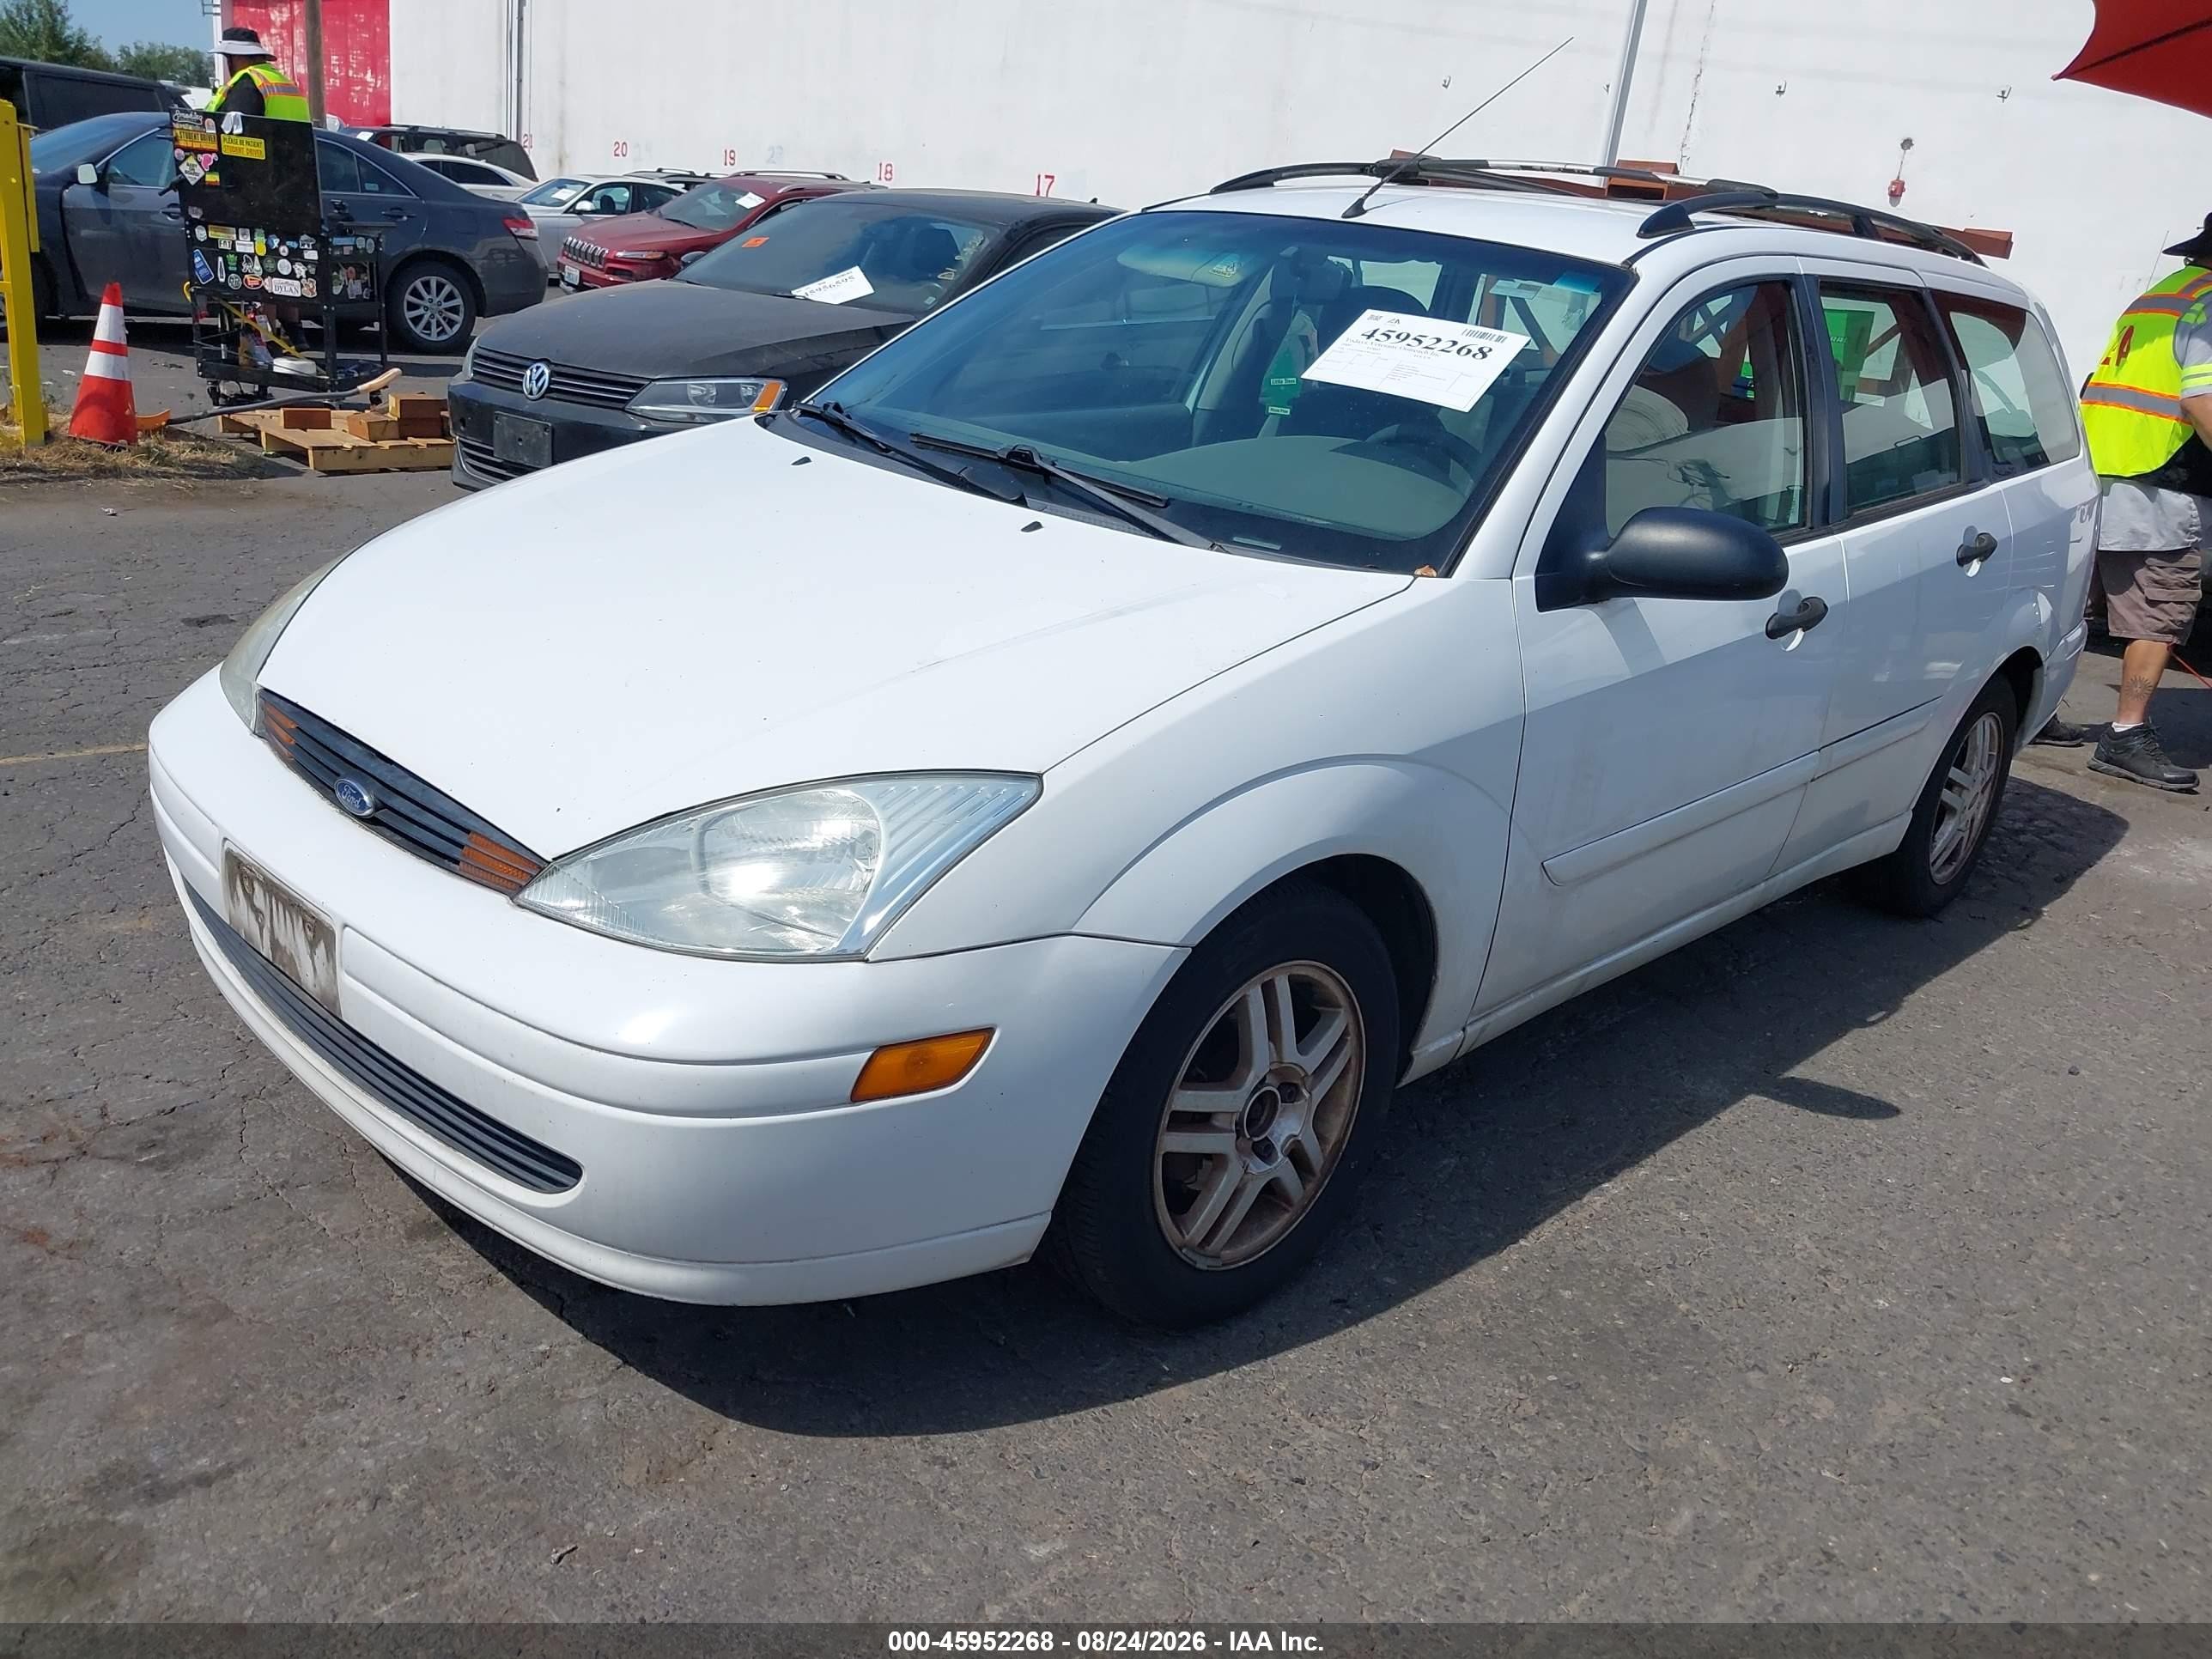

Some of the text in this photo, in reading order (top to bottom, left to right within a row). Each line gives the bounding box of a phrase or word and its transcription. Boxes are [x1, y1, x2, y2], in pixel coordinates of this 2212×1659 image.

[523, 134, 533, 149] 21
[614, 141, 628, 157] 20
[724, 149, 736, 167] 19
[878, 162, 893, 181] 18
[1036, 174, 1055, 198] 17
[274, 284, 299, 295] DYLAN
[1361, 327, 1492, 360] 45952268
[342, 784, 363, 809] Ford
